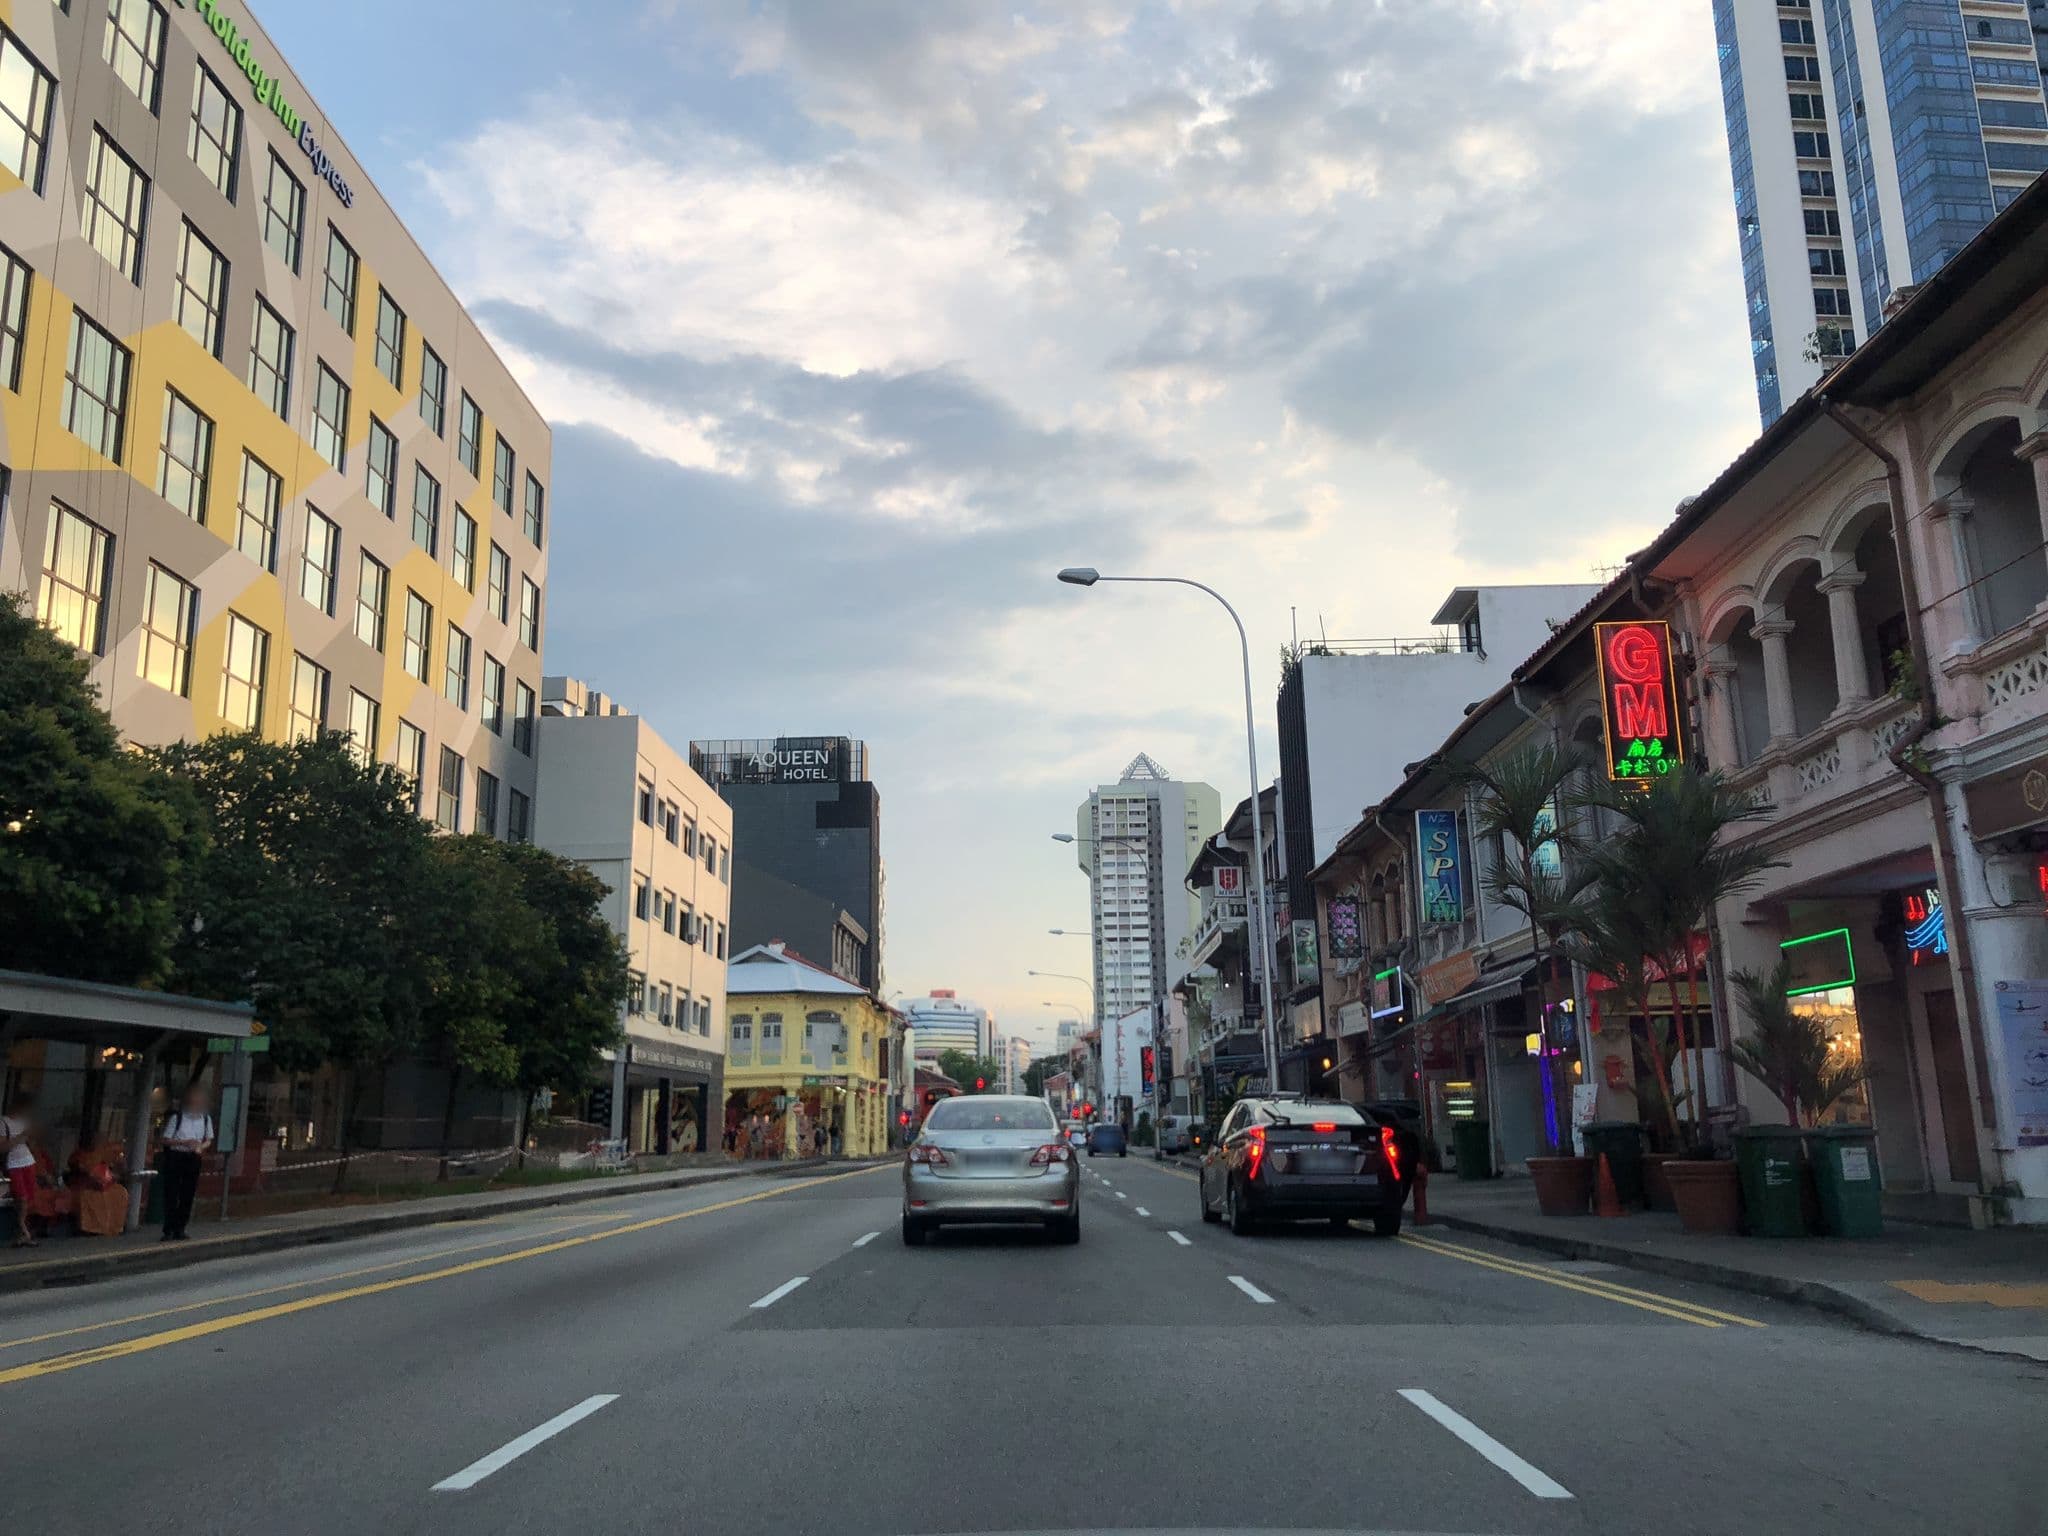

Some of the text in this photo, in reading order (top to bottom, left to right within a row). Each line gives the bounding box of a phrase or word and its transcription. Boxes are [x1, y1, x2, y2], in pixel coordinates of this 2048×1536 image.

[196, 0, 354, 208] Holiday Inn Express
[1610, 626, 1668, 738] GM
[748, 750, 829, 767] AQUEEN
[783, 768, 828, 780] HOTEL
[1427, 831, 1456, 905] SPA
